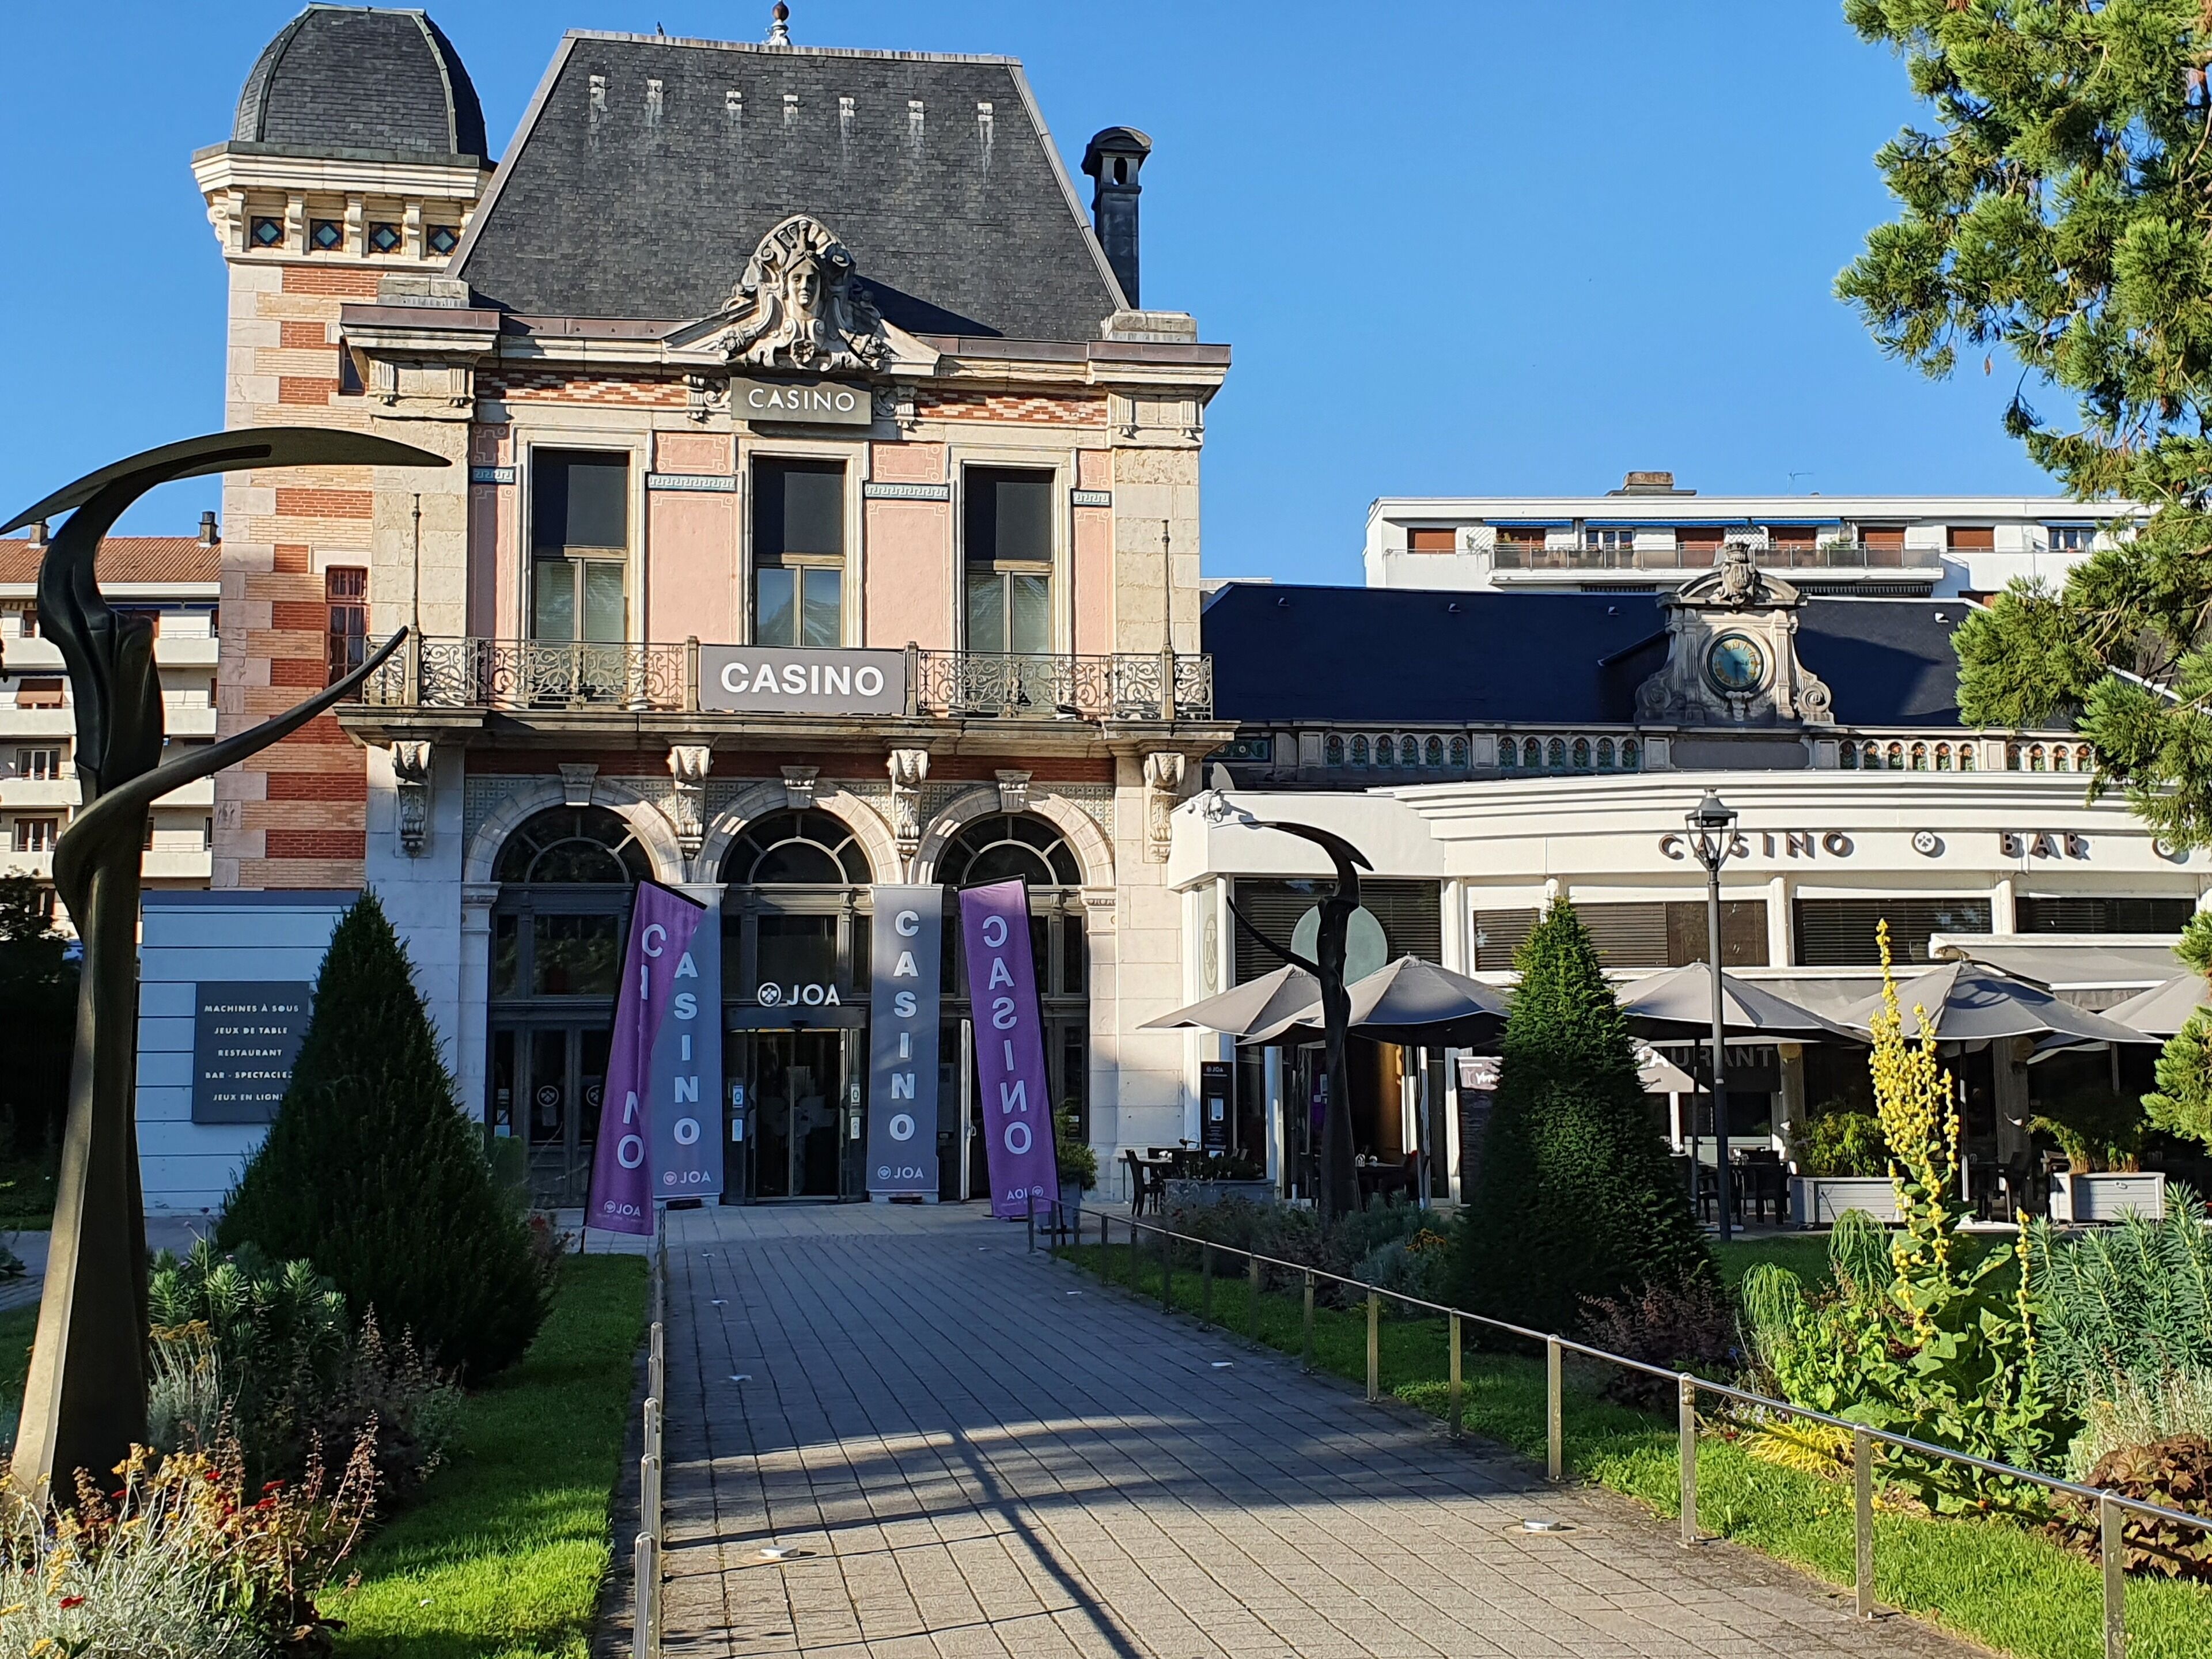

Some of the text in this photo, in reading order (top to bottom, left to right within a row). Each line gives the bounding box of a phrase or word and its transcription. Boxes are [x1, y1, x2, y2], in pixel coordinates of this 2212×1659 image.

[748, 388, 855, 412] CASINO
[721, 662, 884, 696] CASINO
[1999, 831, 2090, 860] BAR
[786, 983, 841, 1006] JOA
[204, 1005, 257, 1013] MACHINES
[272, 1005, 299, 1013] SOUS
[214, 1027, 288, 1035] JEUX DE TABLE
[889, 910, 919, 1142] CASINO
[673, 926, 701, 1145] ASINO
[218, 1049, 282, 1057] RESTAURANT
[680, 1170, 711, 1184] JOA
[893, 1166, 924, 1179] JOA
[616, 1203, 641, 1217] JOA
